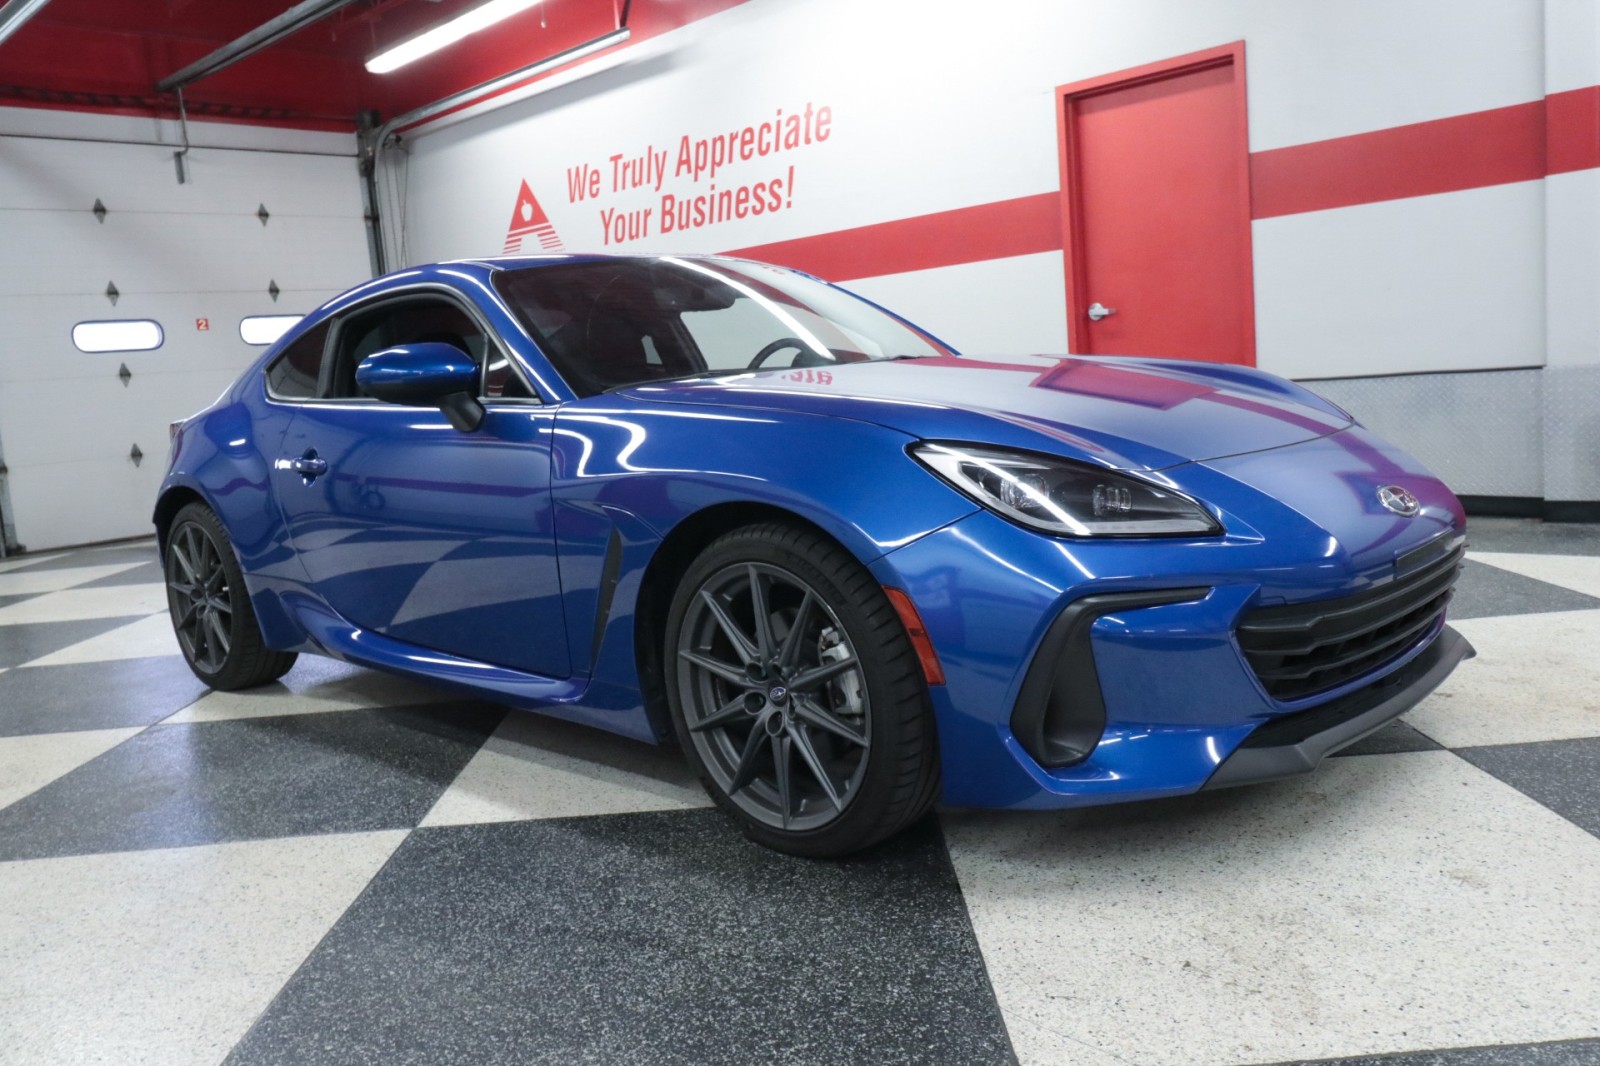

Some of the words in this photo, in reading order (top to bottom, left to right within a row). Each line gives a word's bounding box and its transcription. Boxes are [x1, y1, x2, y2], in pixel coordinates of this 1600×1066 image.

[567, 163, 600, 203] We
[609, 145, 667, 192] Truly
[675, 101, 832, 183] Appreciate
[600, 207, 652, 246] Your
[660, 165, 794, 234] Business!
[198, 319, 208, 330] 2
